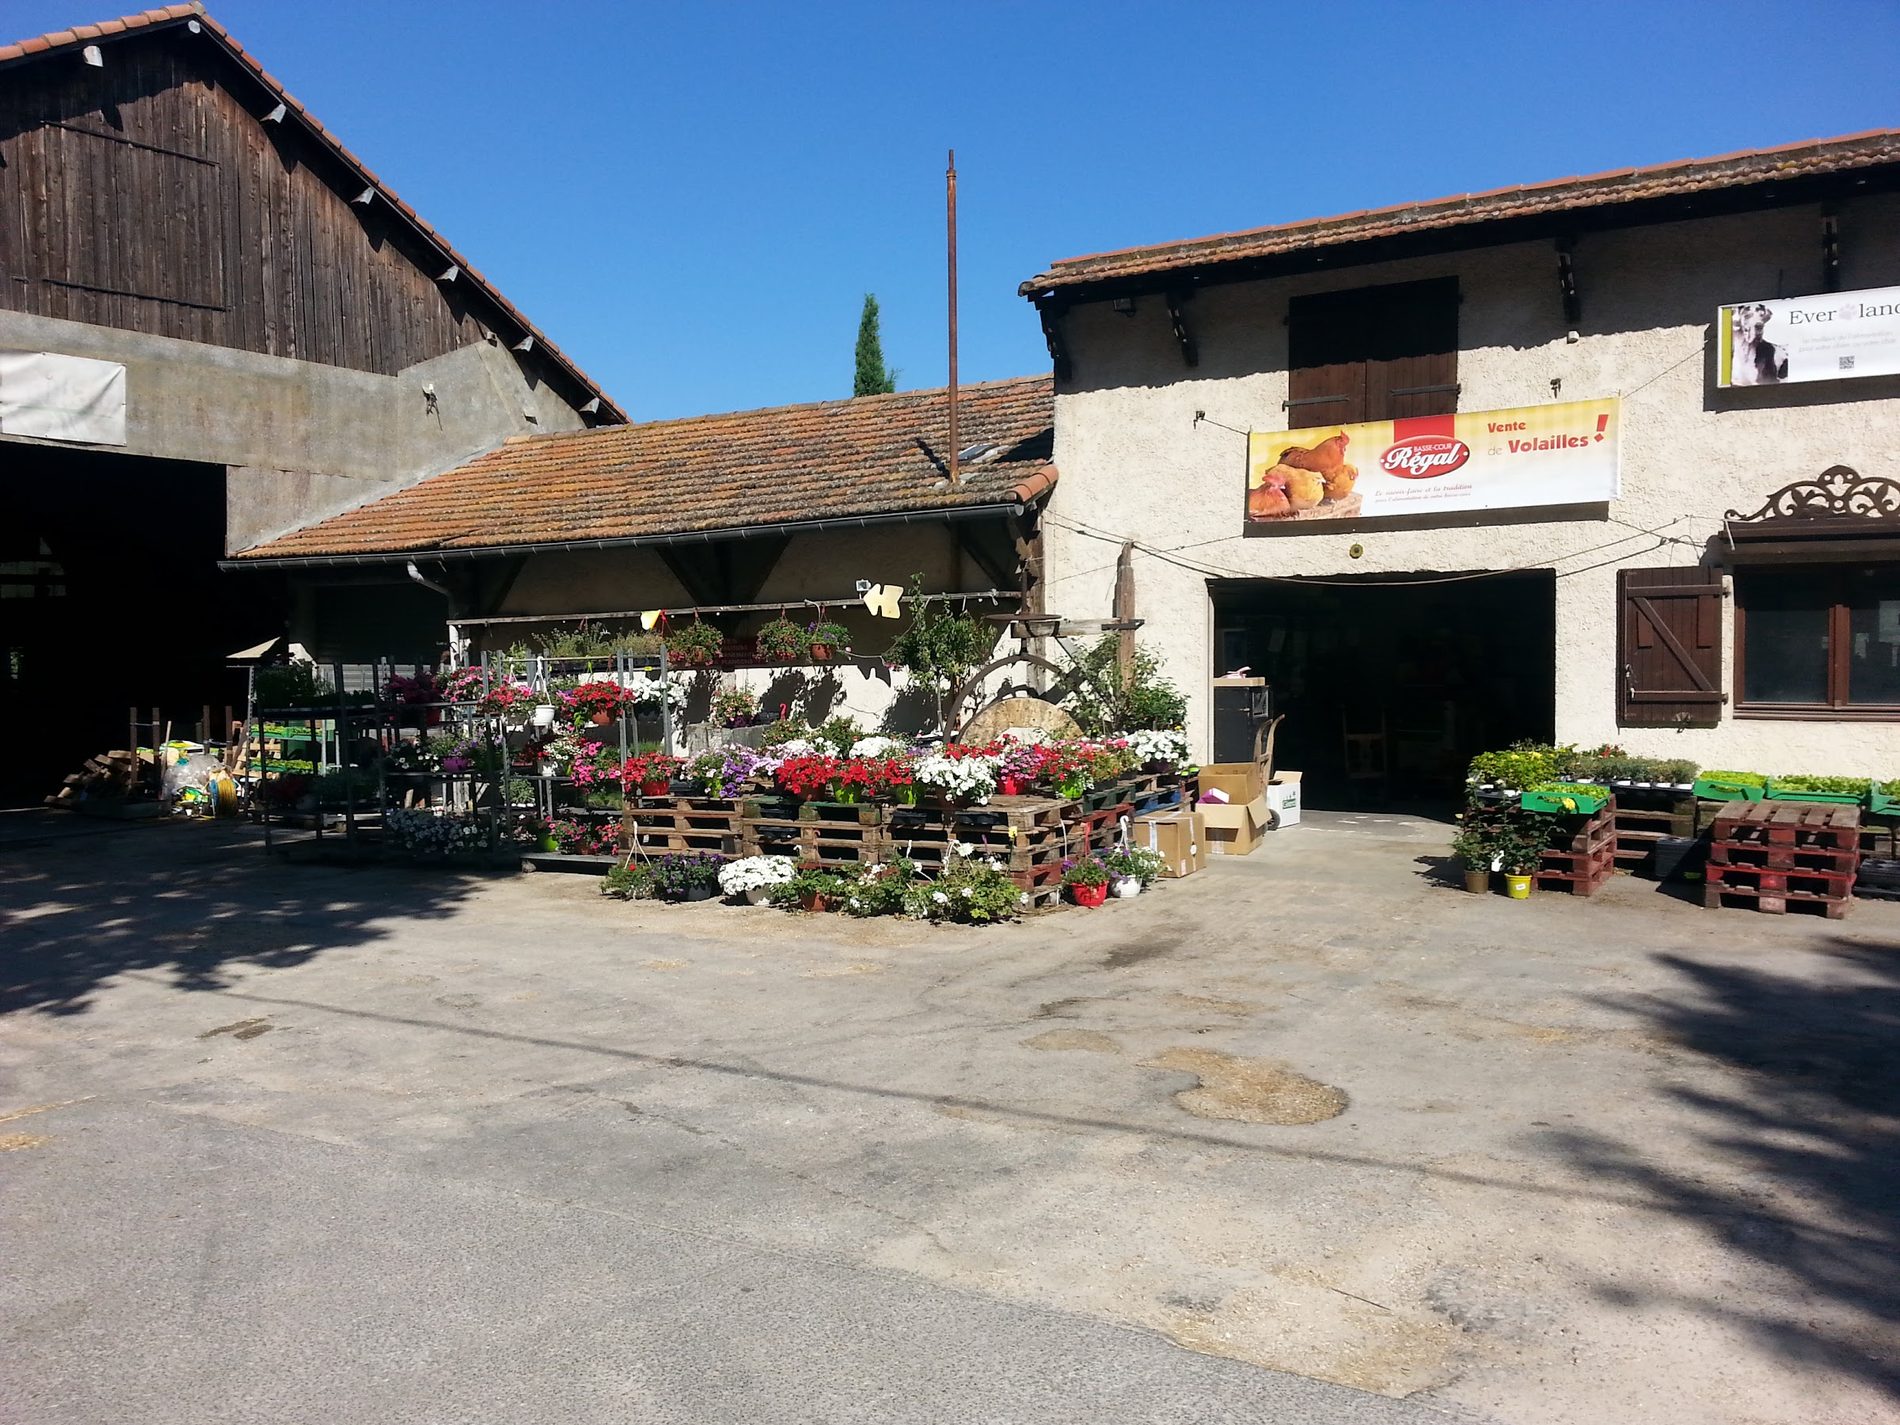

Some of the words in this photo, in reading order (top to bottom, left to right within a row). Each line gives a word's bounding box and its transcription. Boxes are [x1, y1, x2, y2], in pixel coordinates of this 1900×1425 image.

[1789, 310, 1837, 325] Ever
[1487, 421, 1526, 433] Vente
[1413, 443, 1453, 453] BASSE-COUR
[1487, 446, 1503, 456] de
[1508, 434, 1589, 454] Volailles
[1384, 442, 1462, 475] Régal
